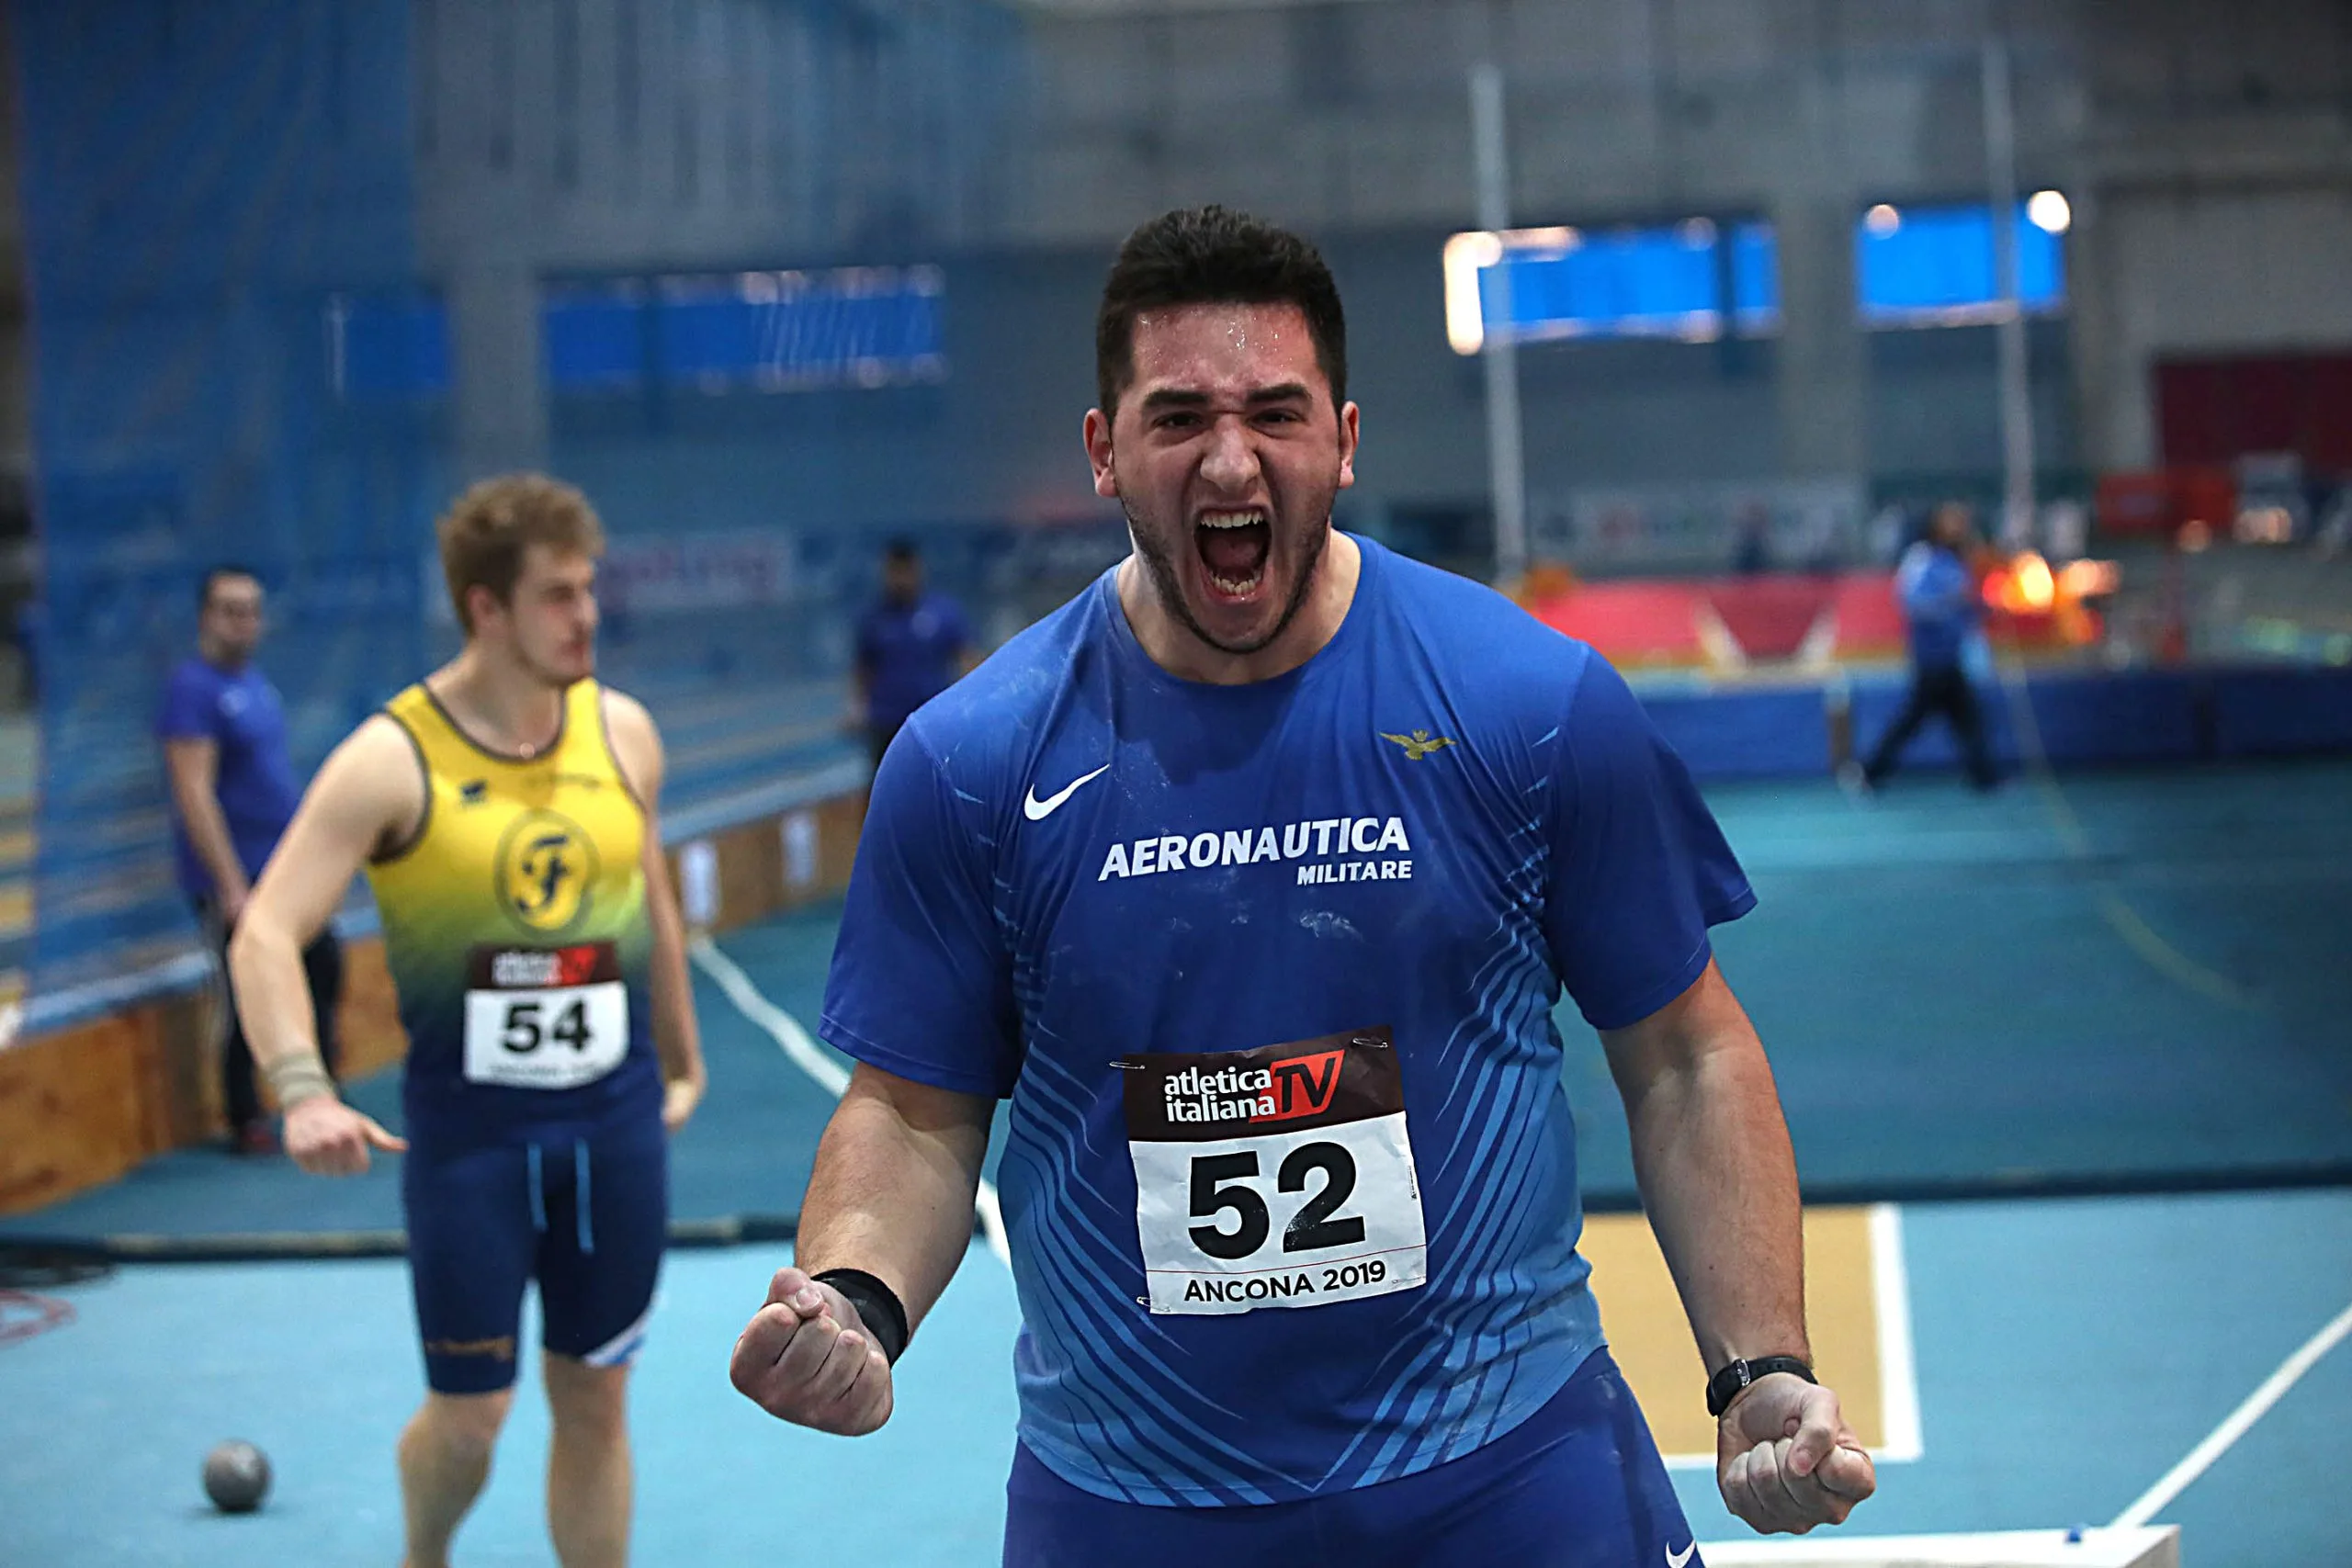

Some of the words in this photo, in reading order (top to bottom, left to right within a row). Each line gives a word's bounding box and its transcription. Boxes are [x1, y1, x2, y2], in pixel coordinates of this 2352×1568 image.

[1098, 817, 1411, 882] AERONAUTICA
[1296, 860, 1413, 886] MILITARE
[502, 999, 593, 1055] 54
[1164, 1066, 1272, 1096] atletica
[1274, 1057, 1337, 1112] TV
[1166, 1093, 1275, 1122] italiana
[1188, 1142, 1365, 1259] 52
[1183, 1273, 1315, 1303] ANCONA
[1323, 1260, 1385, 1292] 2019
